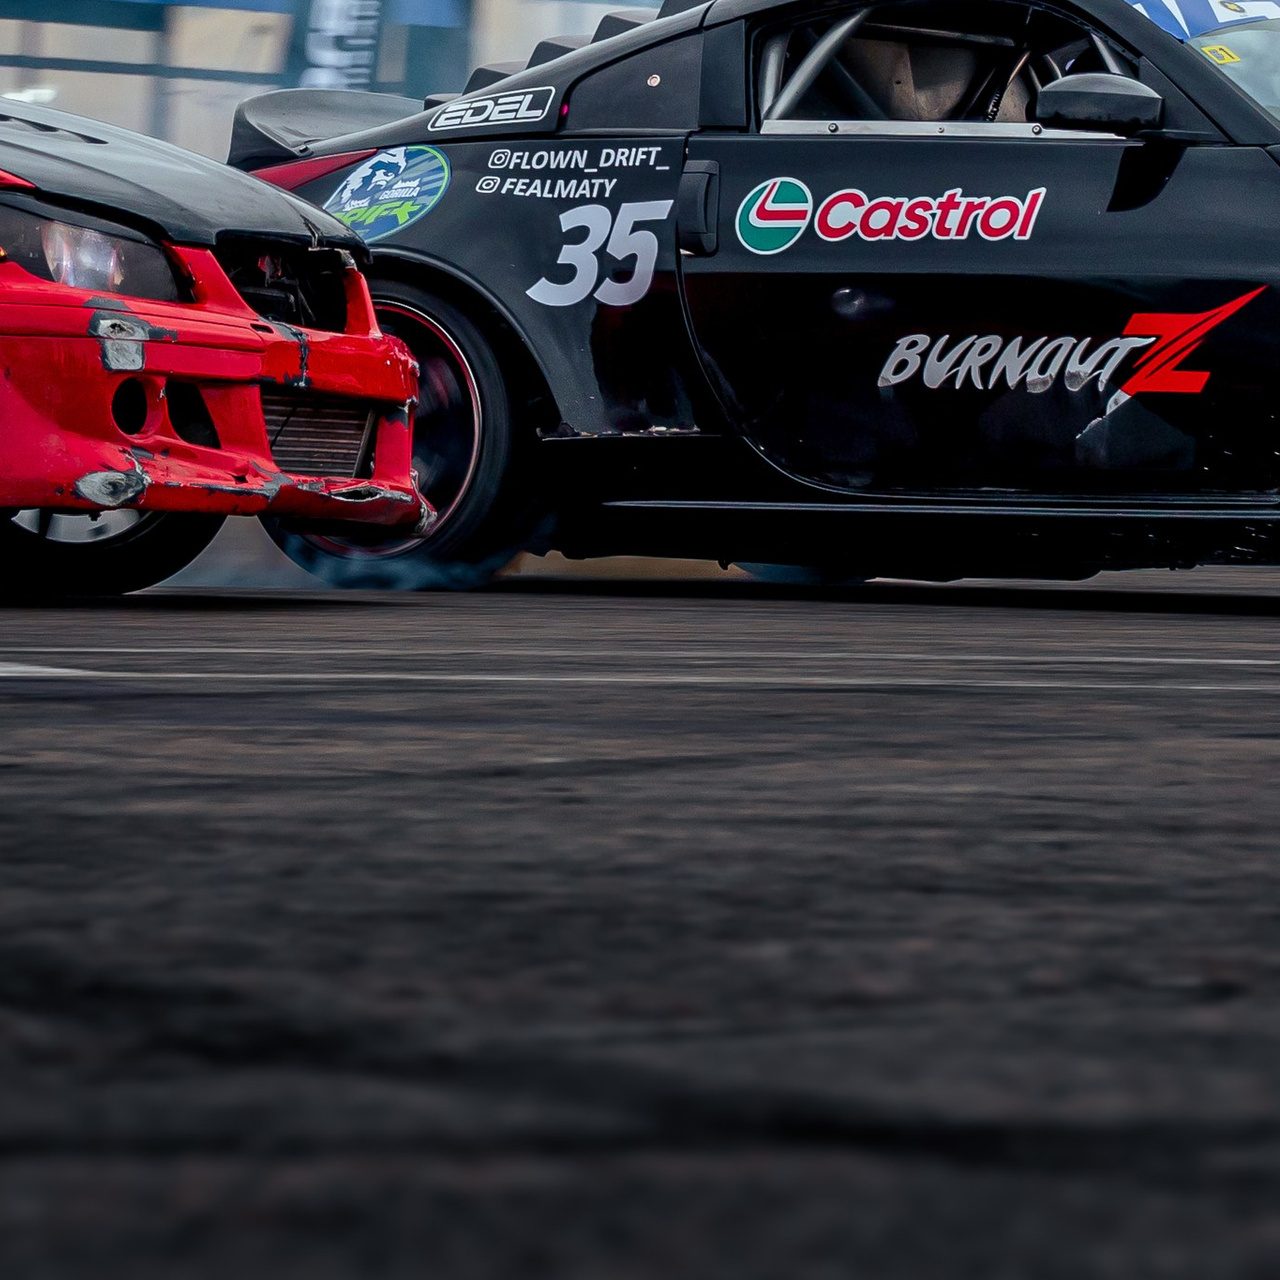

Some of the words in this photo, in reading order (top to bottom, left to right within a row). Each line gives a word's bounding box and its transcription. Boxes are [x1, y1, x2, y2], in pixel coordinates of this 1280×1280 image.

[433, 93, 543, 128] EDEL
[379, 186, 421, 200] GORILLA
[500, 177, 618, 199] FEALMATY
[814, 186, 1048, 242] Castrol
[525, 199, 675, 307] 35
[877, 333, 1157, 394] BURNOUT
